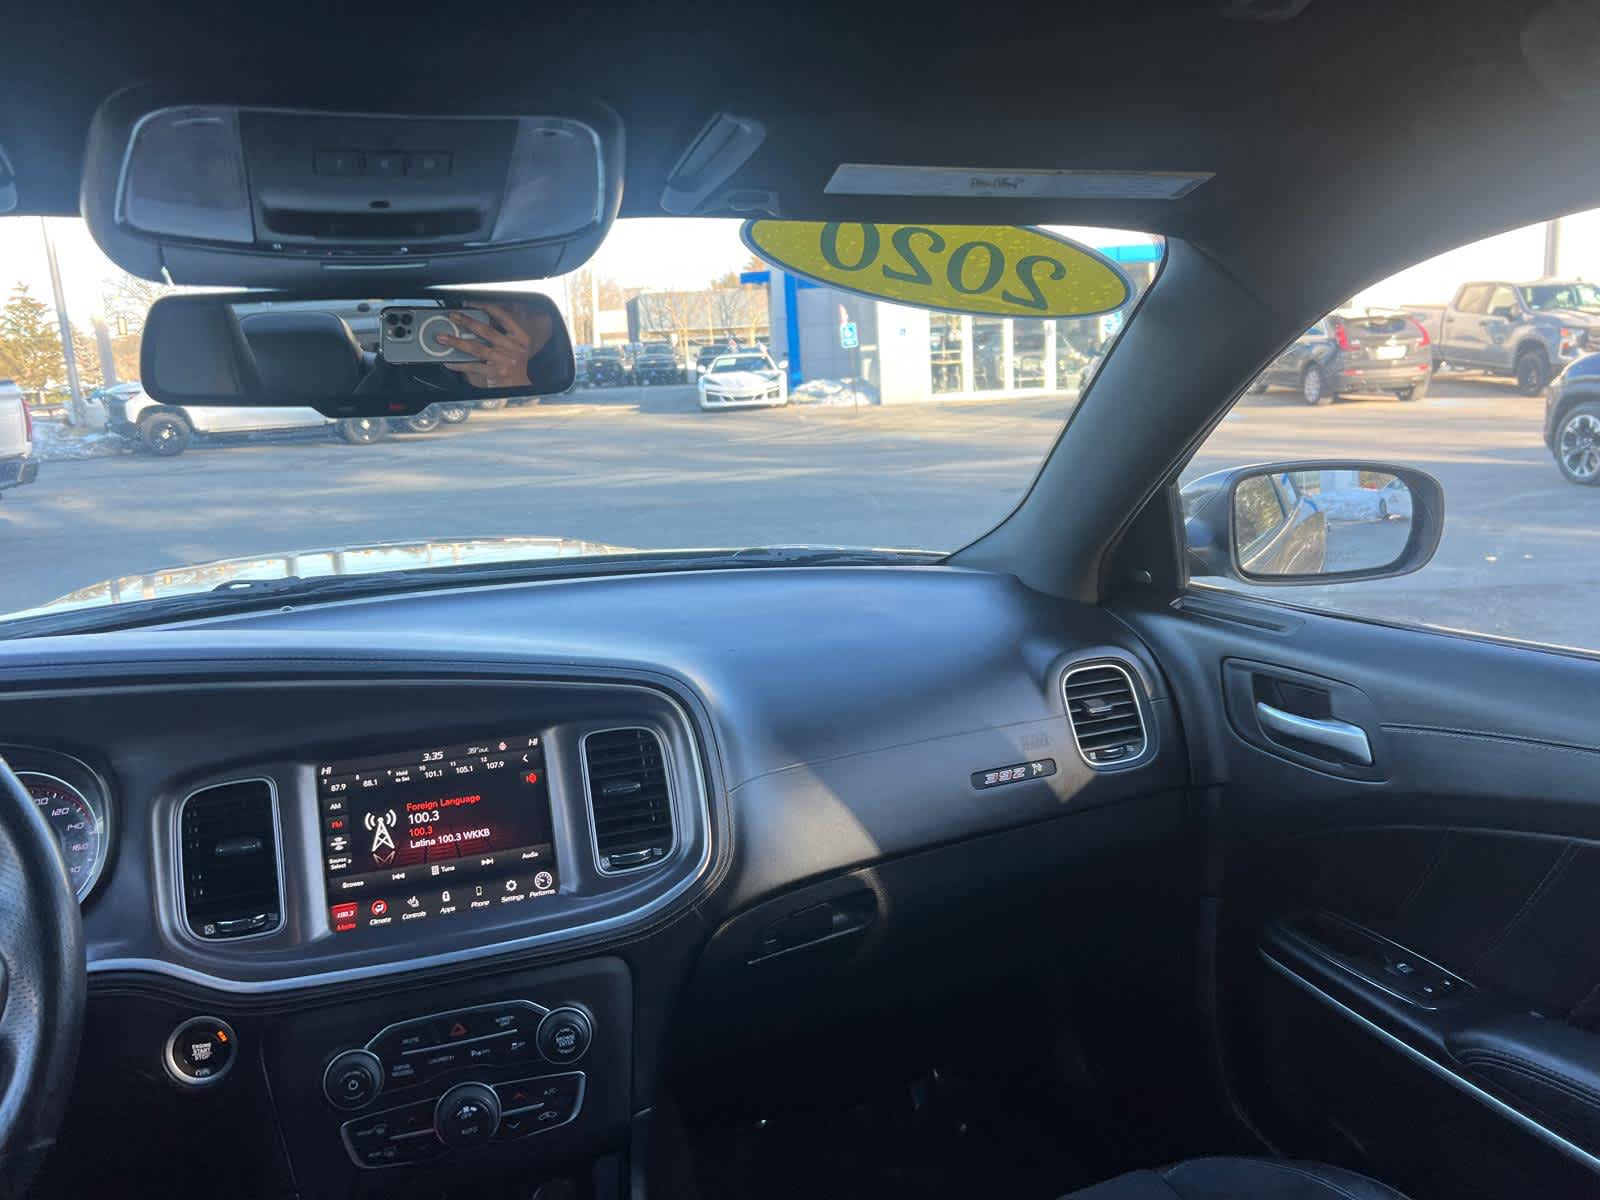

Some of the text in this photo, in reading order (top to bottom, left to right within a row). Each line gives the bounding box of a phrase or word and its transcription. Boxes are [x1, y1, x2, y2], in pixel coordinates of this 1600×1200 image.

[422, 751, 444, 762] 3:35
[455, 765, 474, 774] 105.1
[486, 761, 505, 770] 107.9
[424, 769, 443, 779] 101.1
[985, 767, 1025, 785] 392
[330, 783, 346, 792] 87.9
[406, 795, 481, 811] Foreign Language
[52, 807, 70, 817] 120
[408, 810, 440, 825] 100.3
[67, 822, 85, 831] 140
[409, 825, 433, 837] 100.3
[410, 828, 491, 849] Latina 100.3 WKKB
